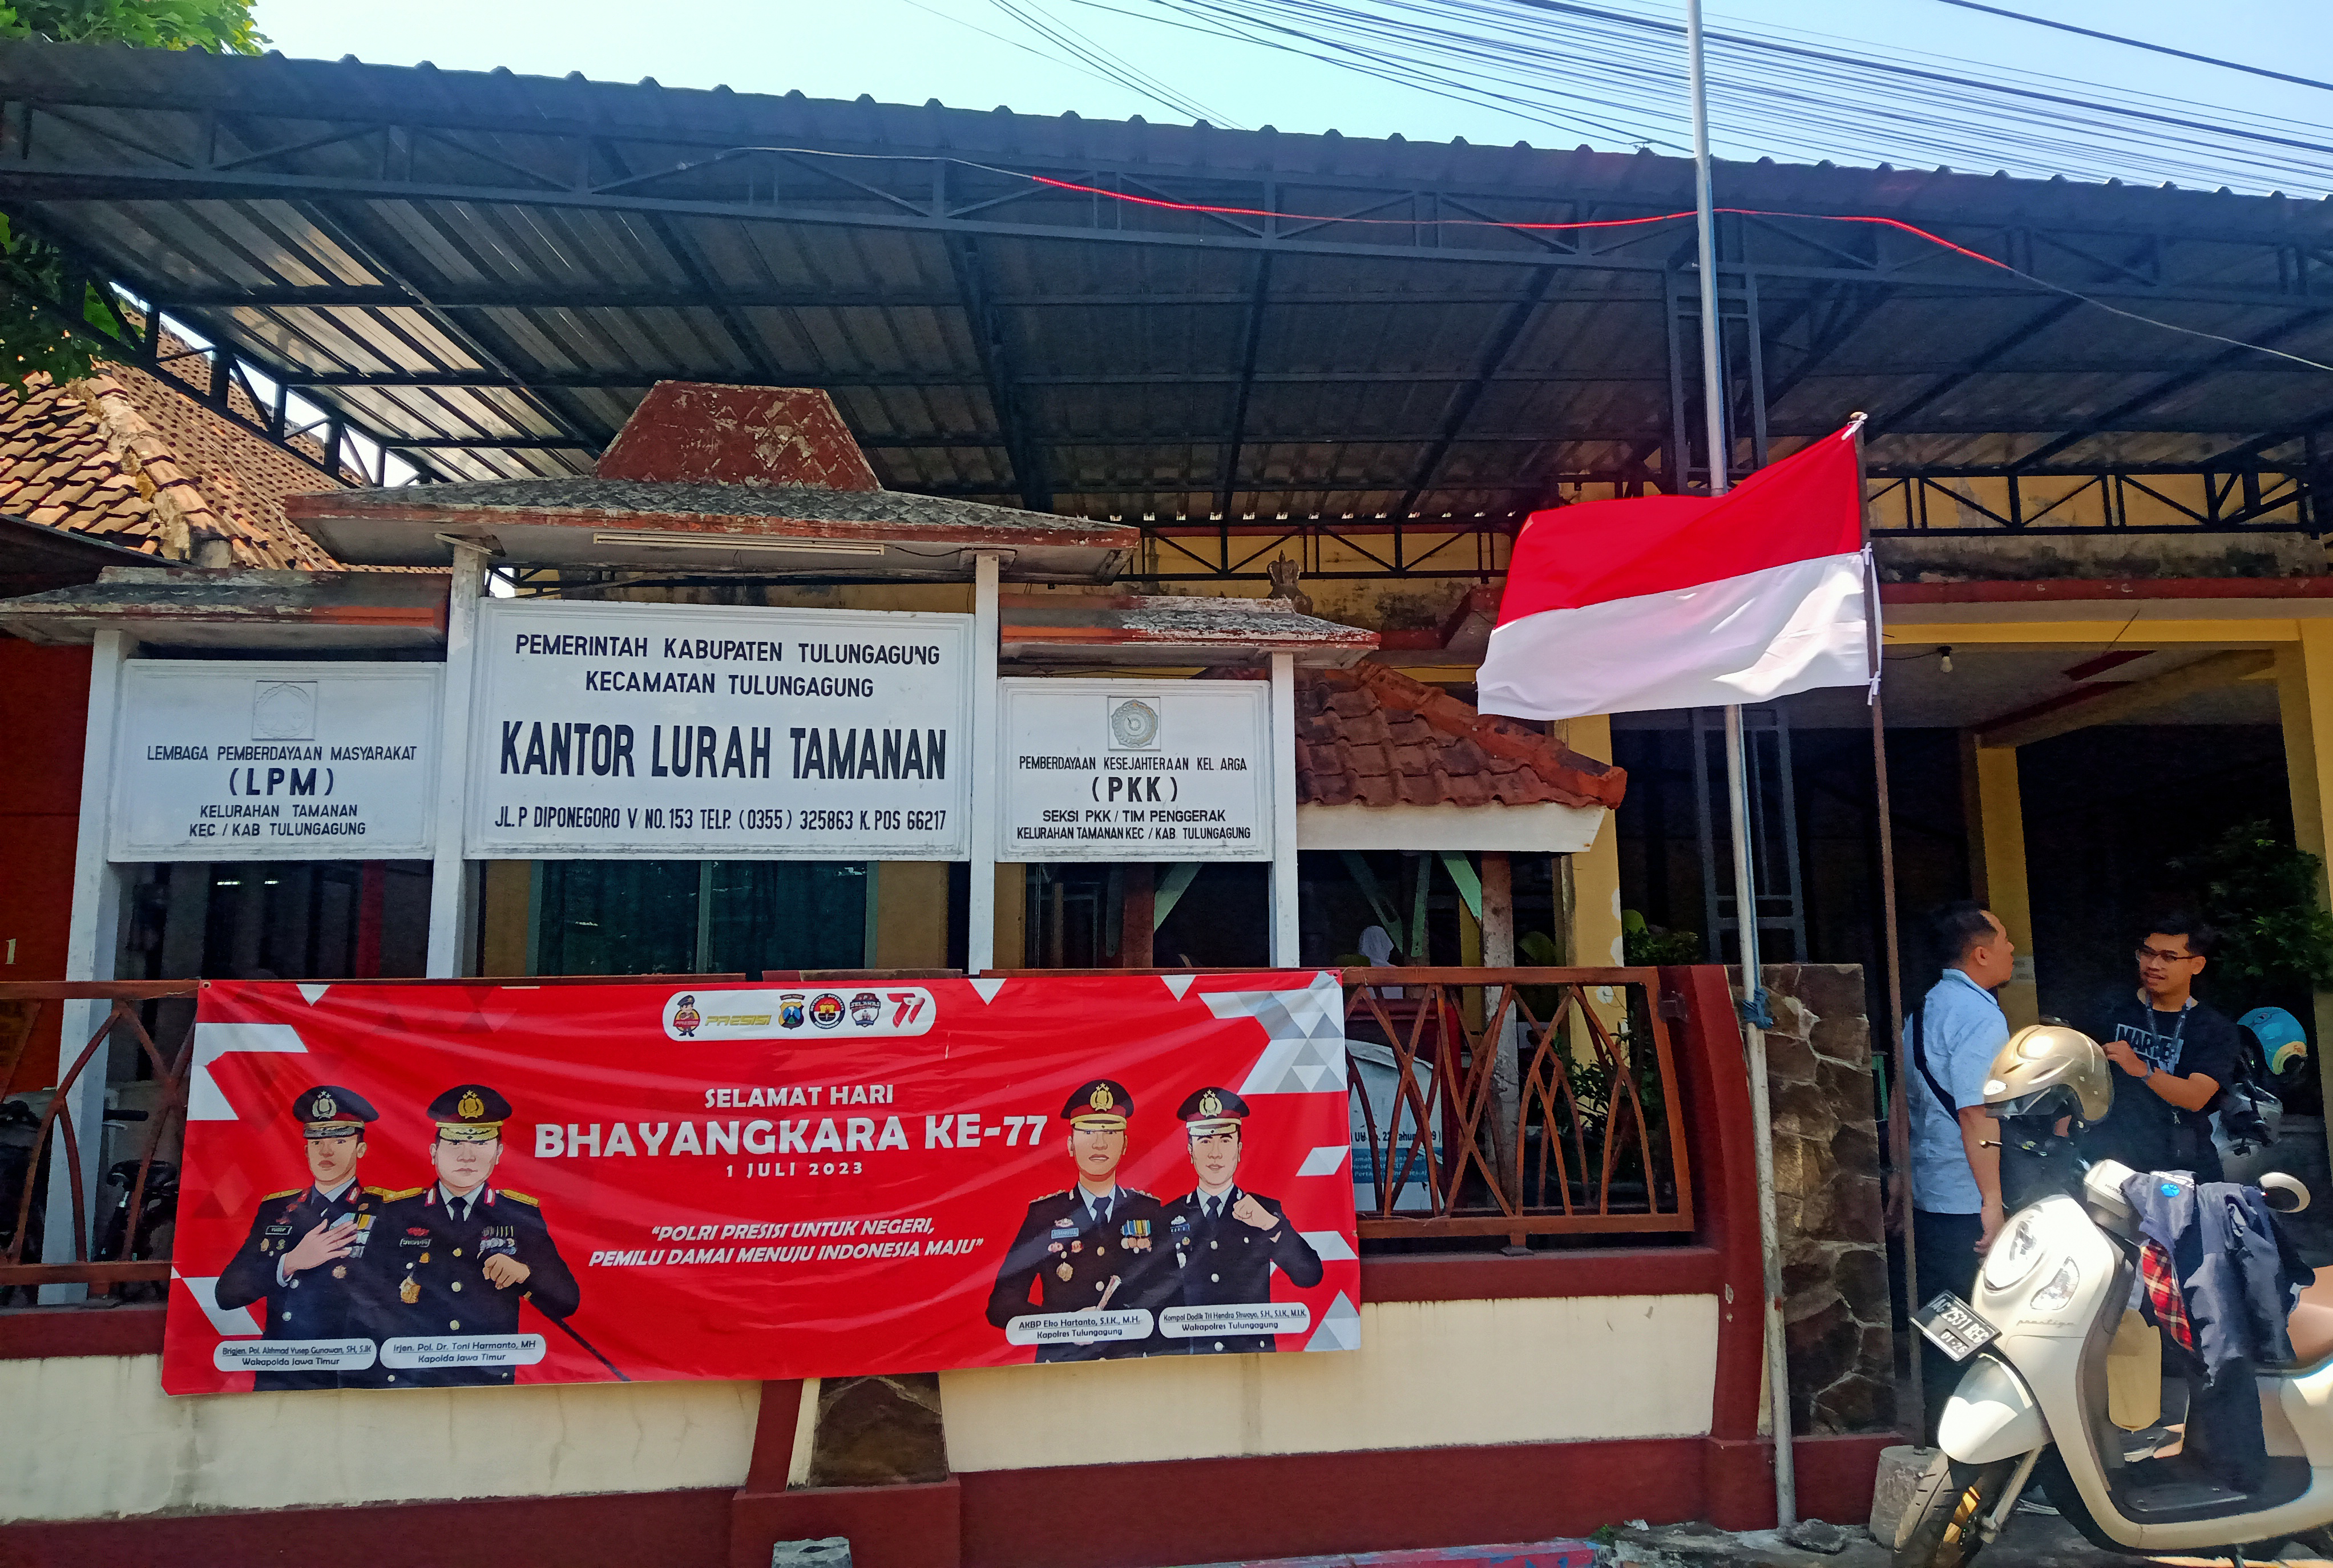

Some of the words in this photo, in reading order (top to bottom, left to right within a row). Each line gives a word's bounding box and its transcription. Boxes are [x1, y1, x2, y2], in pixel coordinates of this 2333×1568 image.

[516, 634, 648, 657] PEMERINTAH
[664, 639, 782, 661] KABUPATEN
[799, 643, 940, 665] TULUNGAGUNG
[586, 671, 716, 693] KECAMATAN
[729, 674, 874, 697] TULUNGAGUNG
[147, 746, 208, 761] LEMBAGA
[217, 746, 322, 761] PEMBERDAYAAN
[331, 746, 417, 761] MASYARAKAT
[500, 721, 635, 777] KANTOR
[651, 725, 771, 779] LURAH
[790, 728, 946, 780] TAMANAN
[1019, 756, 1096, 770] PEMBERDAYAAN
[1104, 757, 1189, 770] KESEJAHTERAAN
[229, 767, 334, 796] (LPM)
[1092, 776, 1178, 802] (PKK)
[200, 805, 279, 818] KELURAHAN
[293, 805, 357, 818] TAMANAN
[534, 807, 620, 829] DIPONEGORO
[627, 808, 638, 829] V
[739, 810, 793, 831] (0355)
[800, 810, 853, 831] 325863
[907, 810, 946, 831] 66217
[1043, 810, 1079, 822] SEKSI
[1086, 810, 1111, 822] PKK
[1122, 810, 1144, 822] TIM
[1150, 810, 1226, 822] PENGGERAK
[189, 823, 216, 837] KEC
[232, 823, 260, 836] KAB
[270, 823, 366, 836] TULUNGAGUNG
[1017, 827, 1074, 839] KELURAHAN
[1077, 827, 1124, 839] TAMANAN
[1125, 827, 1144, 839] KEC
[1156, 827, 1175, 839] KAB
[1183, 827, 1250, 839] TULUNGAGUNG
[705, 1086, 822, 1109] SELAMAT
[829, 1084, 893, 1105] HARI
[534, 1116, 909, 1158] BHAYANGKARA
[925, 1114, 1048, 1149] KE-77
[726, 1165, 733, 1178] 1
[746, 1162, 796, 1179] JULI
[809, 1162, 863, 1177] 2023
[723, 1223, 787, 1239] PRESISI
[794, 1221, 860, 1239] UNTUK
[861, 1218, 935, 1236] NEGERI,
[588, 1250, 664, 1268] PEMILU
[666, 1247, 733, 1266] DAMAI
[736, 1245, 814, 1264] MENUJU
[816, 1241, 921, 1260] INDONESIA
[1019, 1321, 1042, 1329] AKBP
[1060, 1318, 1097, 1327] Hartanto,
[1182, 1323, 1226, 1332] Wakapolres
[1072, 1329, 1122, 1337] Tulungagung
[242, 1358, 289, 1367] Wakapolda
[418, 1355, 454, 1364] Kapolda
